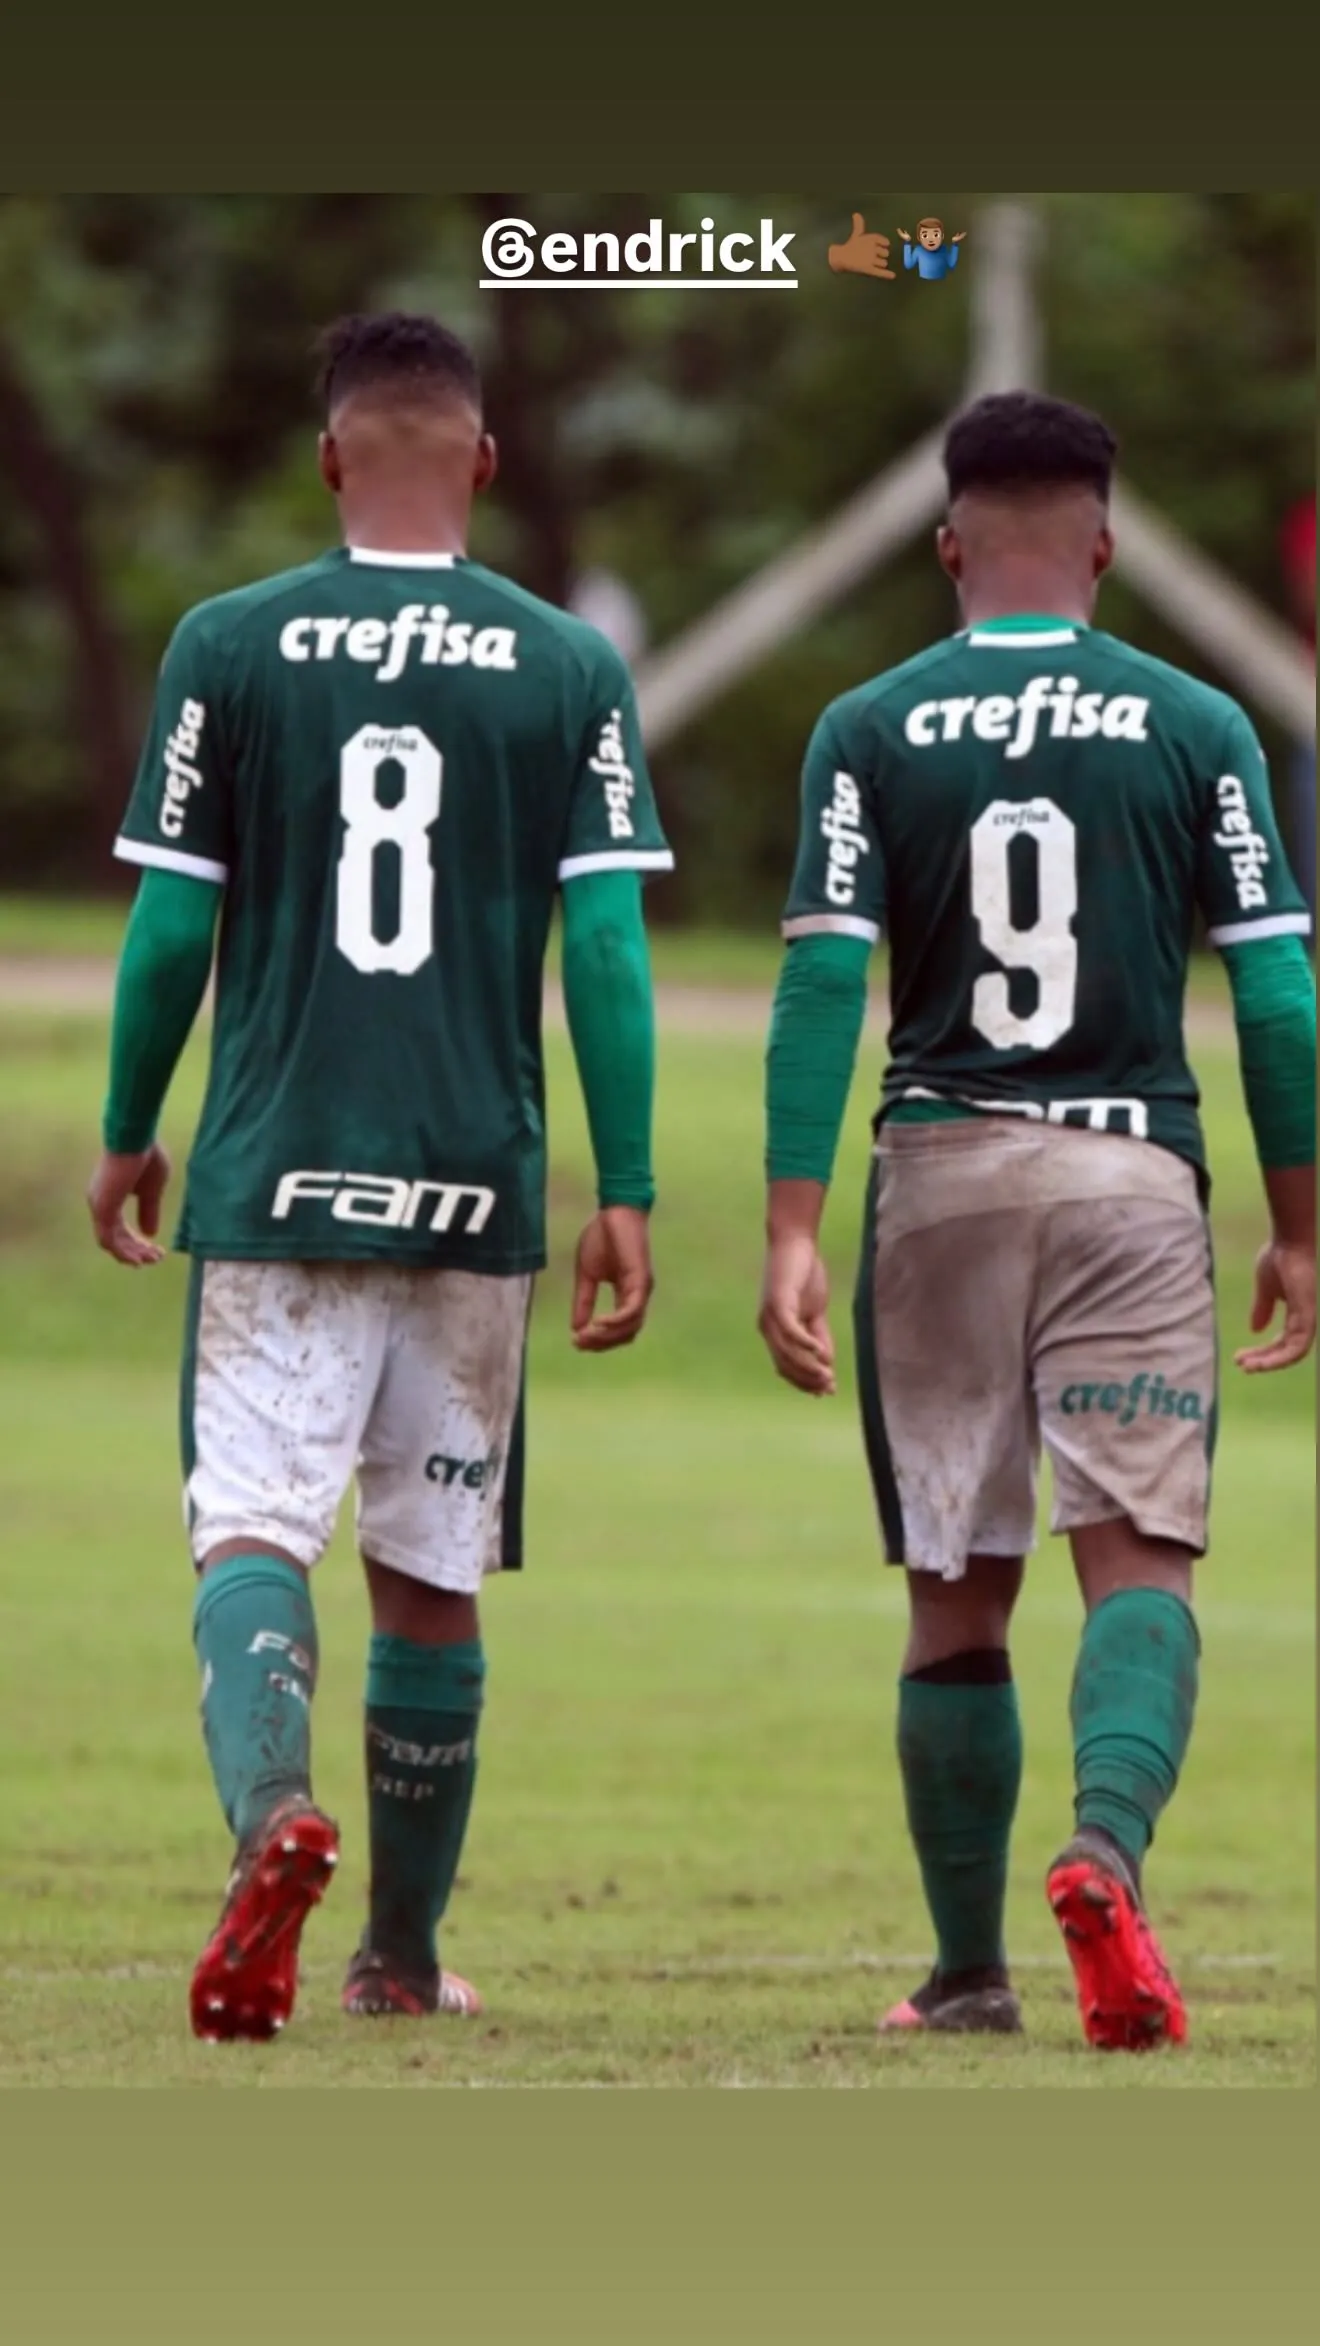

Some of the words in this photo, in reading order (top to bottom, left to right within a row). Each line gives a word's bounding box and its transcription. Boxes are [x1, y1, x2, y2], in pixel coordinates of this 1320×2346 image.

[280, 604, 517, 682] crefisa
[159, 698, 206, 838] crefisa
[905, 676, 1150, 760] crefisa
[336, 723, 443, 976] 8
[821, 771, 869, 905] crefisa
[1214, 774, 1270, 909] crefisa
[970, 797, 1078, 1051] 9
[1060, 1371, 1204, 1427] crefisa
